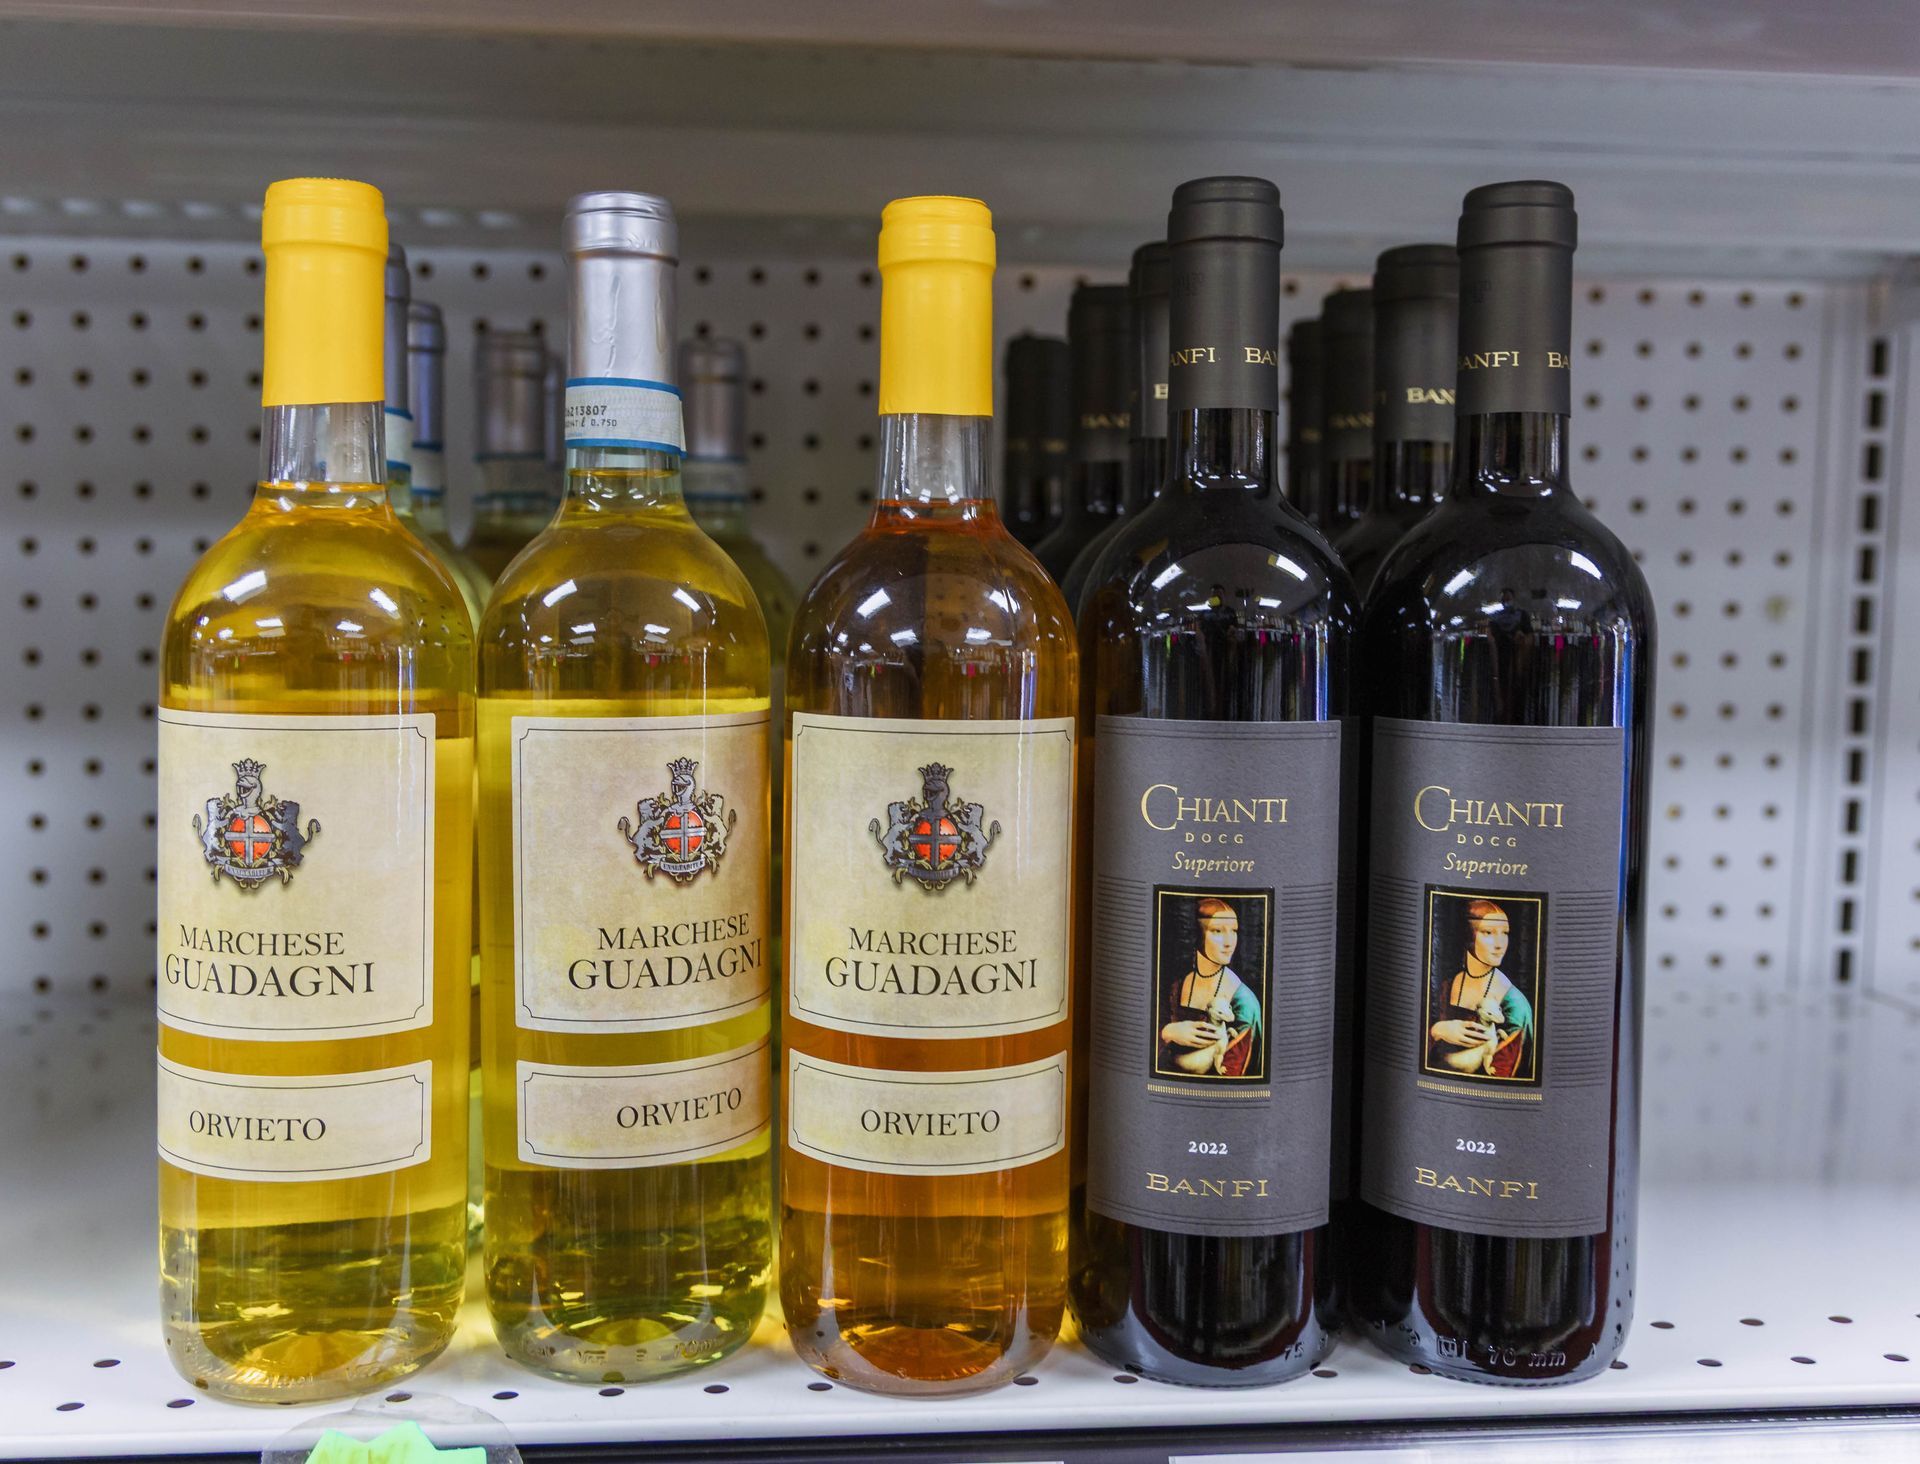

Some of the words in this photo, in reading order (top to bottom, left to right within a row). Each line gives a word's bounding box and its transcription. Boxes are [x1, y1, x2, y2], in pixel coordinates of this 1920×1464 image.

[1141, 784, 1288, 831] CHIANTI
[1414, 786, 1563, 831] CHIANTI
[1185, 832, 1244, 844] DOCG
[1457, 834, 1516, 847] DOCG
[1171, 851, 1255, 877] Superiore
[1443, 852, 1528, 877] Superiore
[180, 924, 344, 956] MARCHESE
[597, 913, 750, 951] MARCHESE
[848, 927, 1017, 956] MARCHESE
[165, 953, 376, 997] GUADAGNI
[568, 939, 763, 991] GUADAGNI
[825, 957, 1038, 996] GUADAGNI
[616, 1088, 742, 1129] ORVIETO
[860, 1109, 1000, 1136] ORVIETO
[189, 1110, 326, 1142] ORVIETO
[1188, 1140, 1228, 1155] 2022
[1455, 1138, 1497, 1155] 2022
[1145, 1172, 1269, 1198] BANFI
[1414, 1166, 1538, 1200] BANFI
